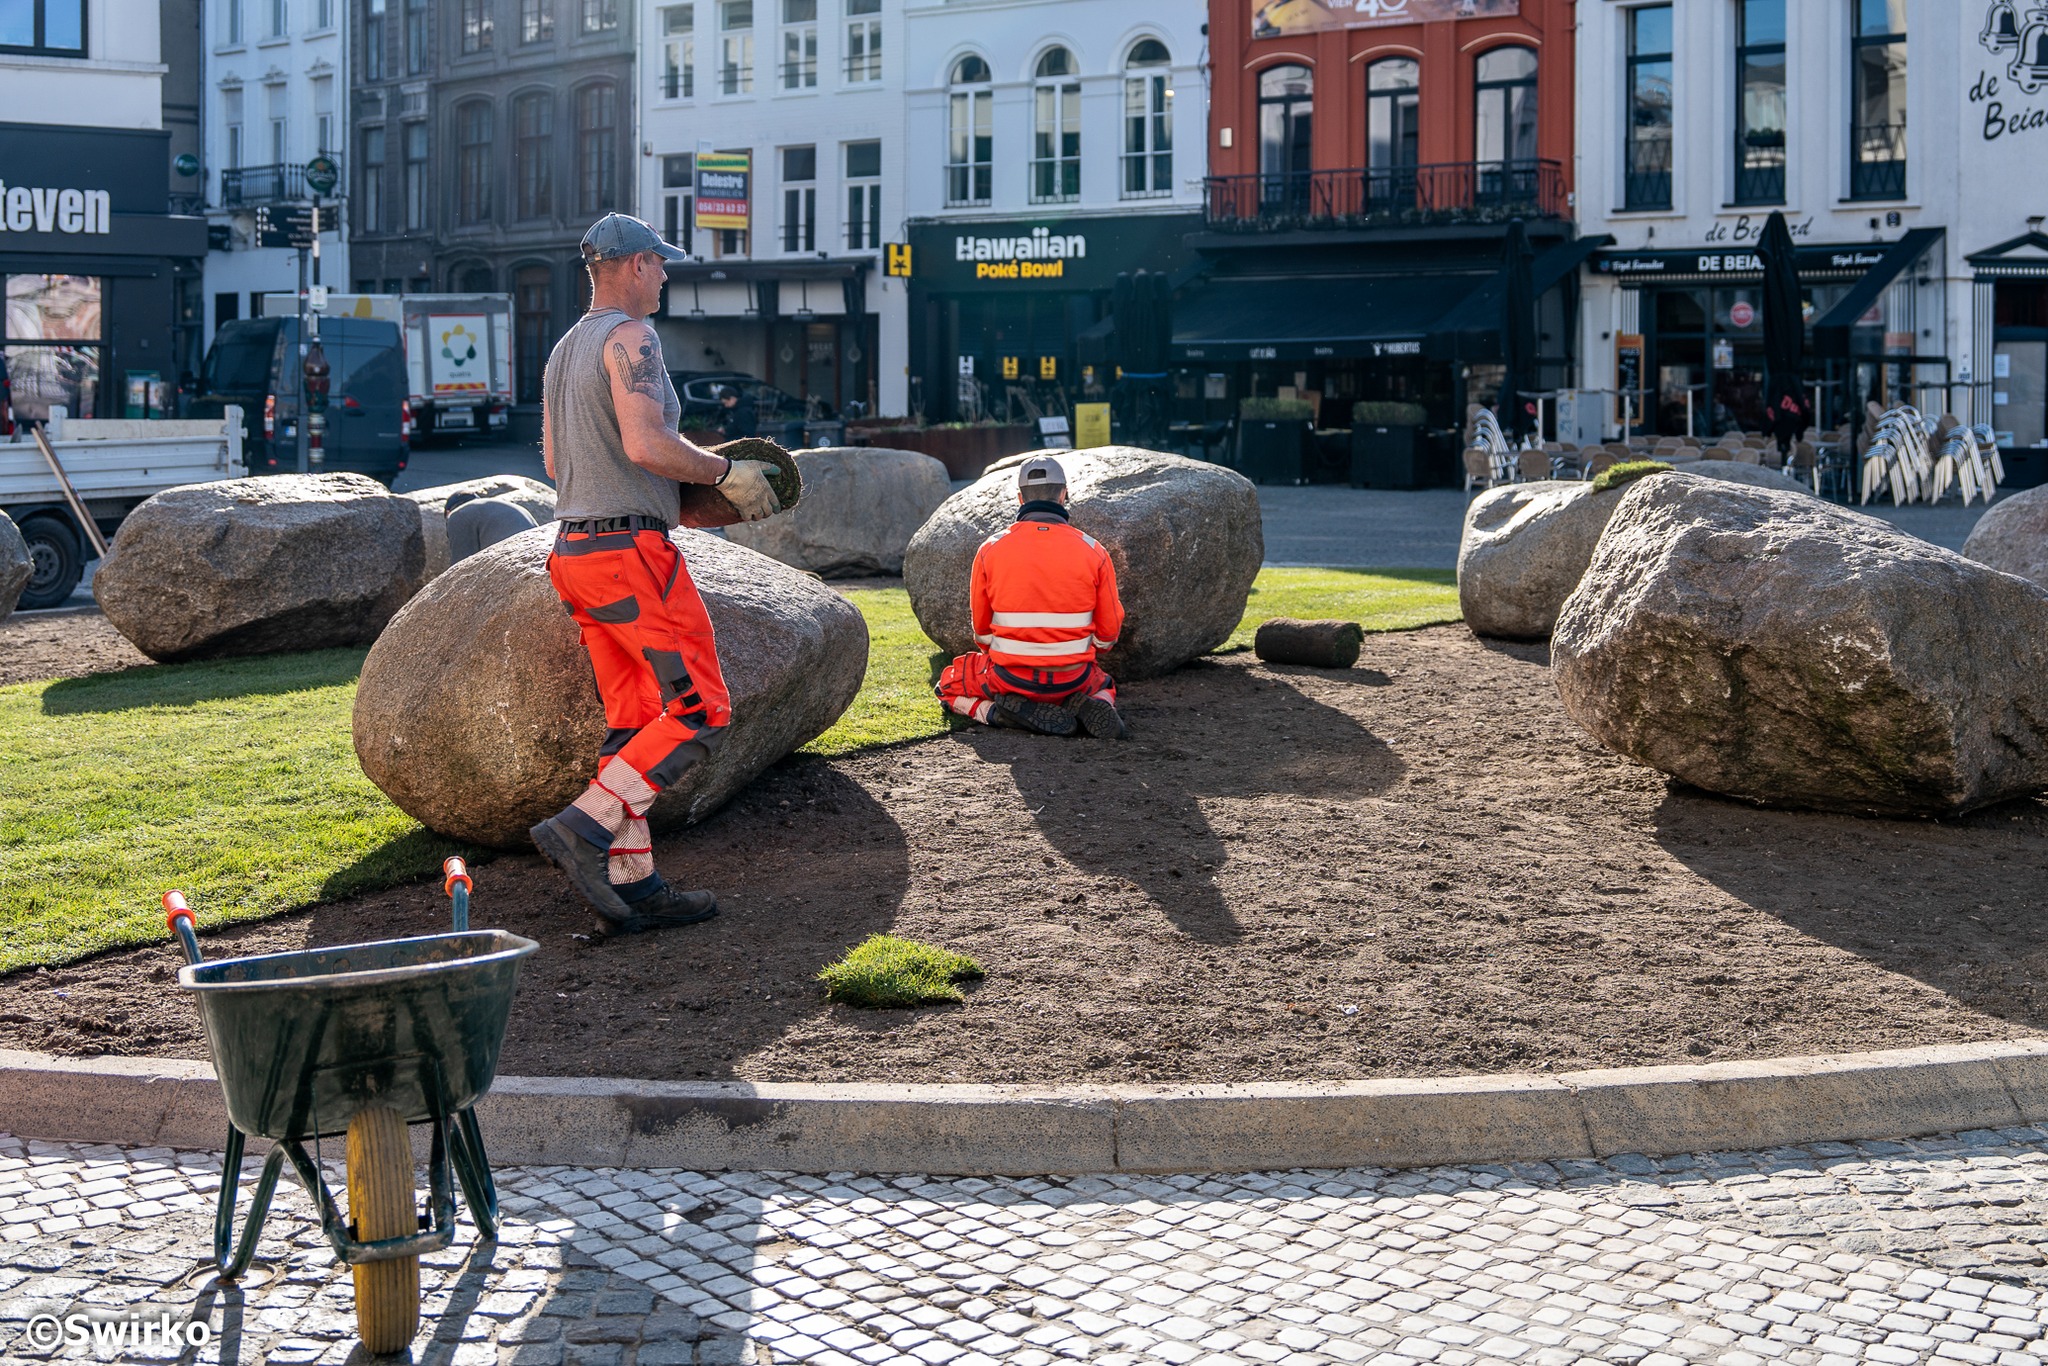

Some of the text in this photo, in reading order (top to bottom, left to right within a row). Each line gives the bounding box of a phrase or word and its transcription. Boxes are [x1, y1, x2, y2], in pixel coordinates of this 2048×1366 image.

[1969, 70, 1999, 102] de
[1983, 101, 2048, 141] Beia
[701, 172, 744, 189] Delestré
[1705, 215, 1814, 241] de Berd
[956, 227, 1086, 260] Hawaiian
[976, 259, 1063, 278] Poké Bowl
[1698, 255, 1765, 271] DE BEIA
